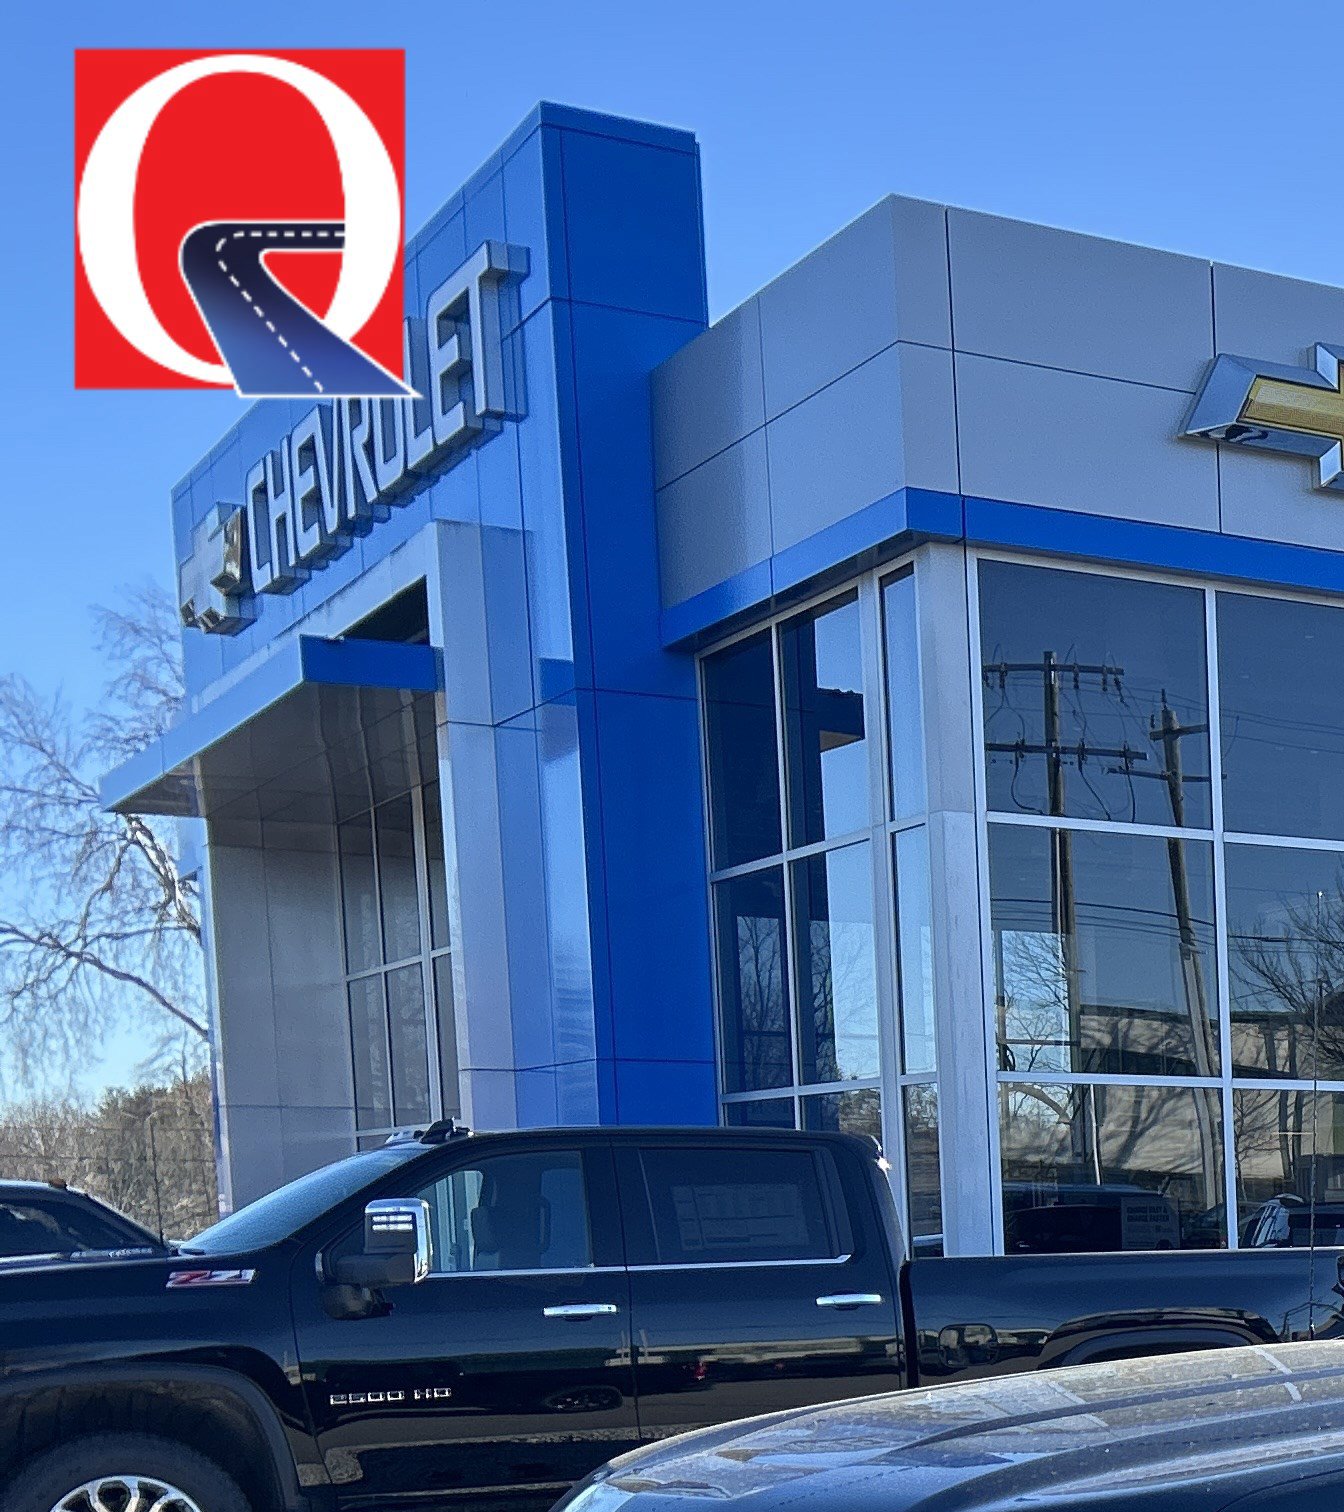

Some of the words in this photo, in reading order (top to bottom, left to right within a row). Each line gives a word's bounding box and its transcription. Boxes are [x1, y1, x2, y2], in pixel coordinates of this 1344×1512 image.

[245, 241, 530, 594] CHEVROLET
[166, 1269, 256, 1288] Z71
[329, 1390, 405, 1405] 2500
